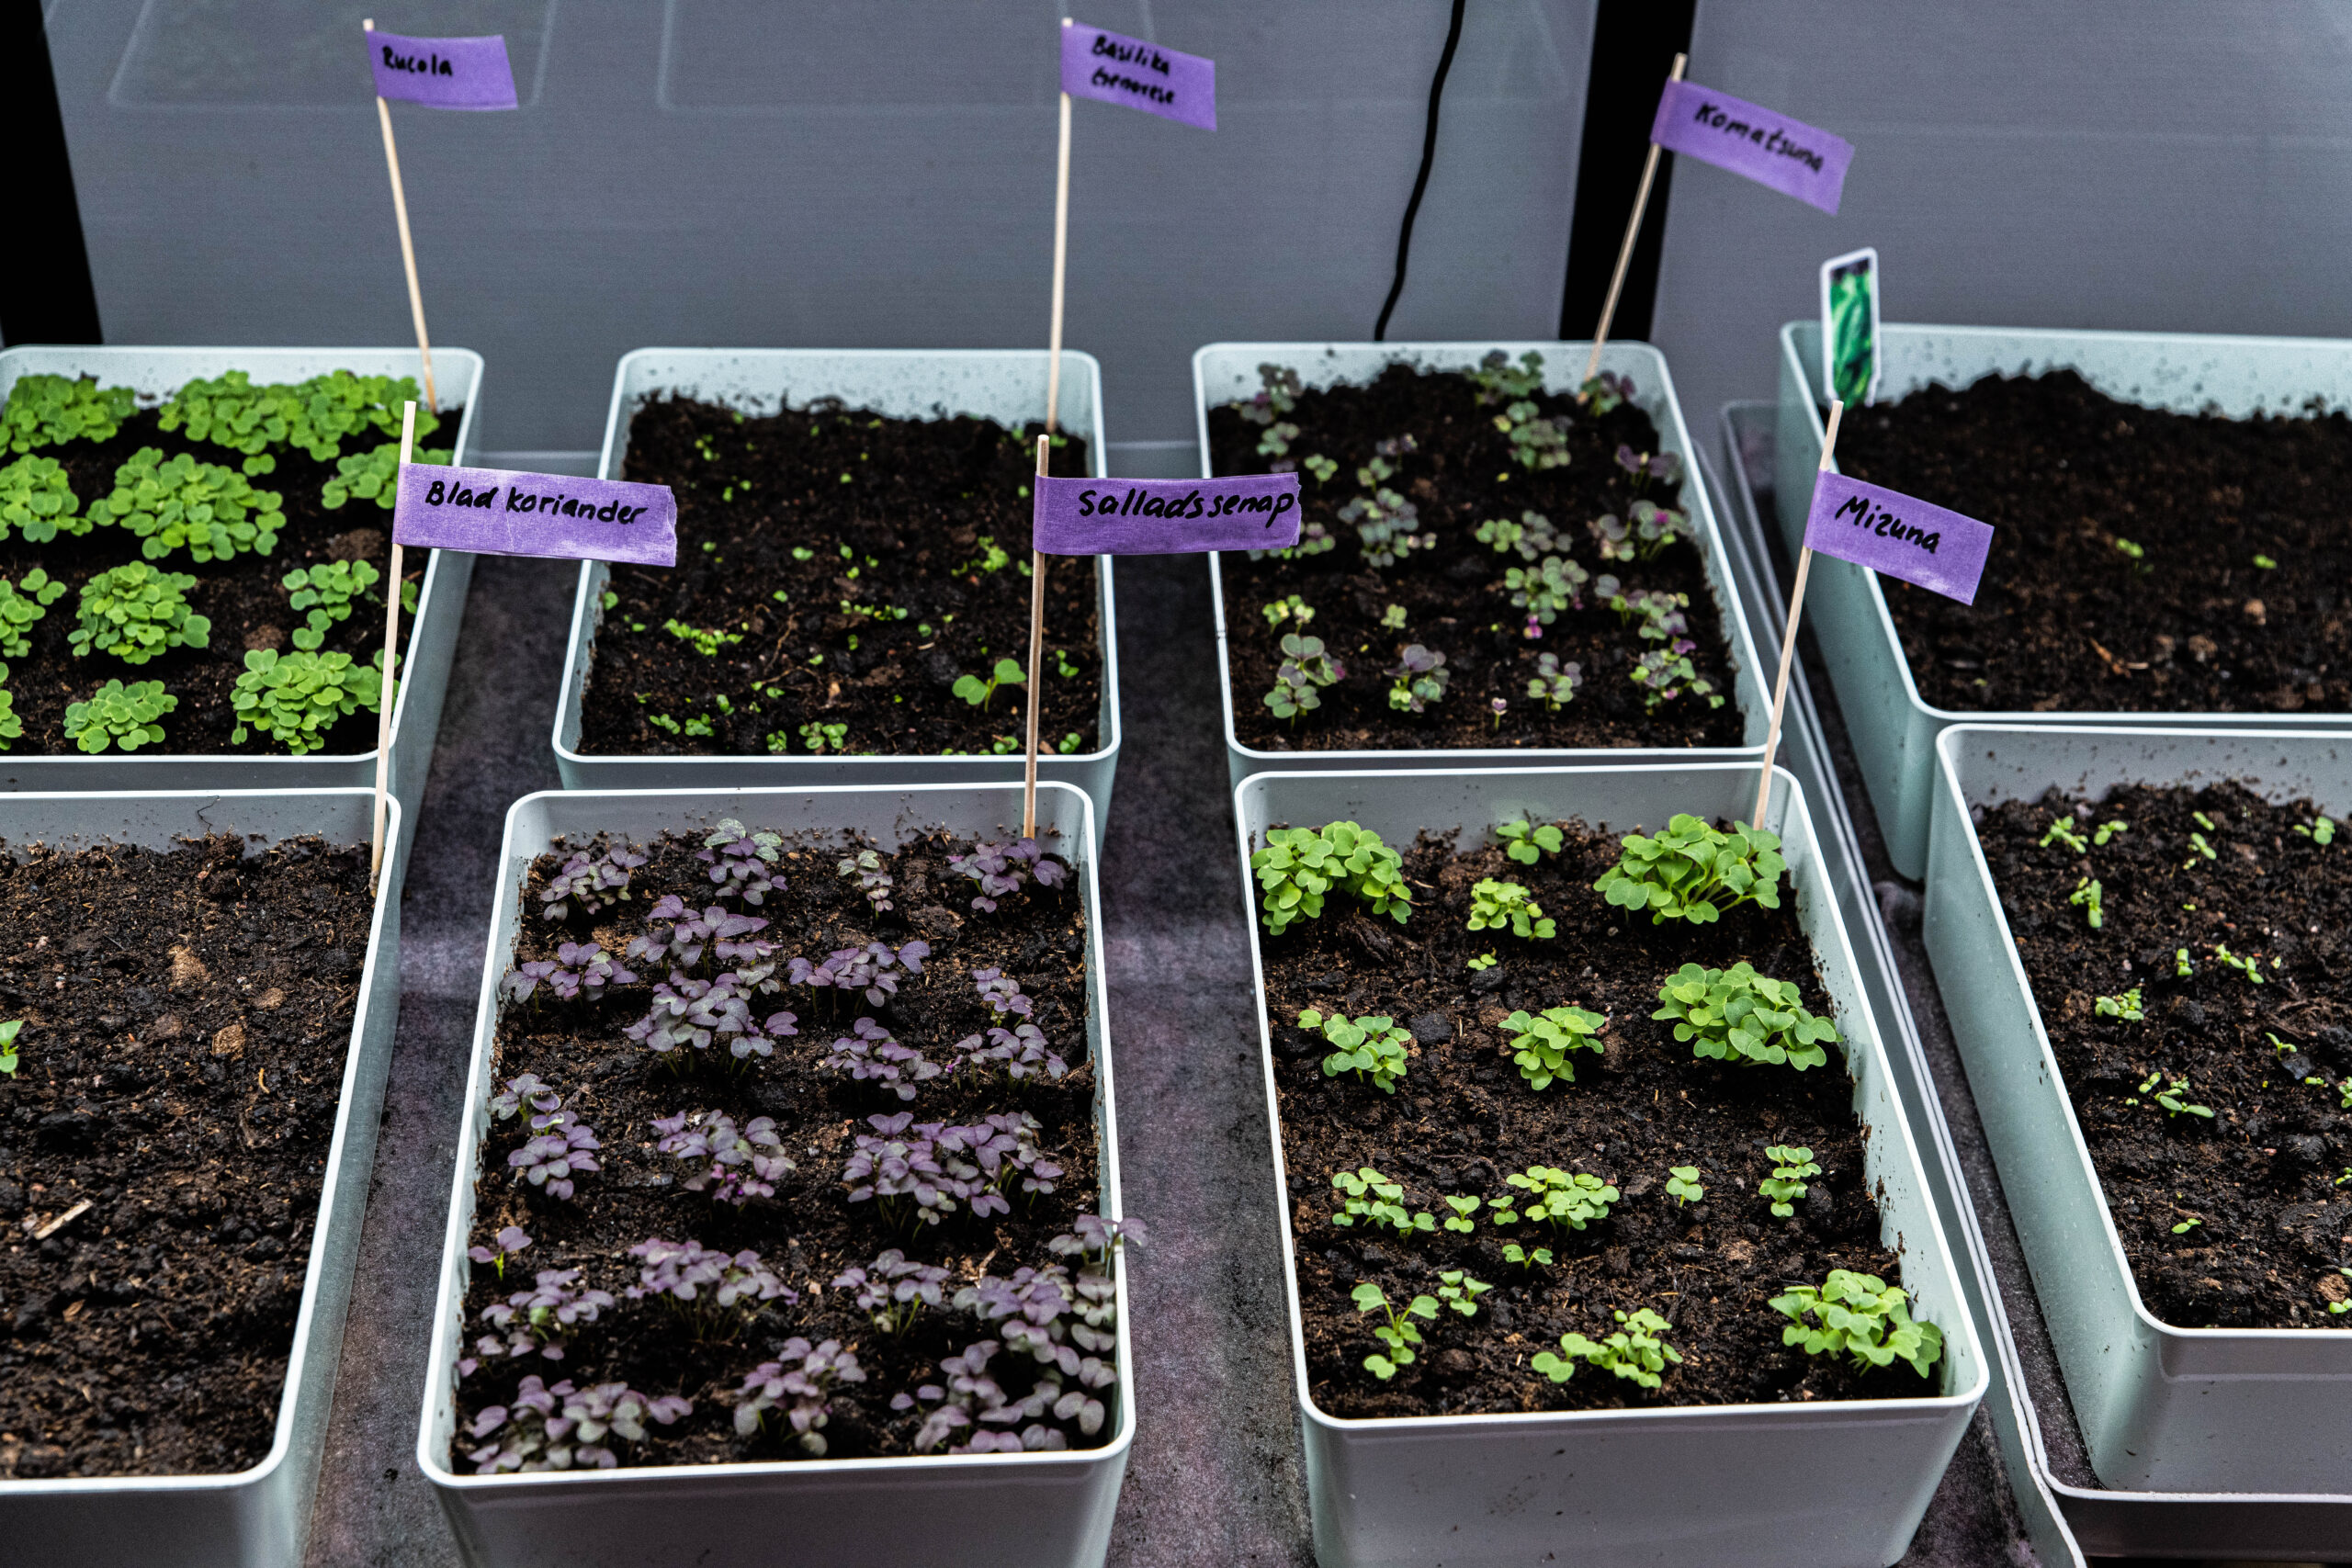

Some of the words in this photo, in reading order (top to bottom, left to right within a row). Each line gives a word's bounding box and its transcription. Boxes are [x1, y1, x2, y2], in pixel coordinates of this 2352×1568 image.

[381, 44, 454, 77] Rucola
[1694, 101, 1825, 173] Komatsuna
[424, 480, 500, 510] Blad
[505, 486, 649, 525] koriander
[1834, 495, 1941, 555] Mizuna
